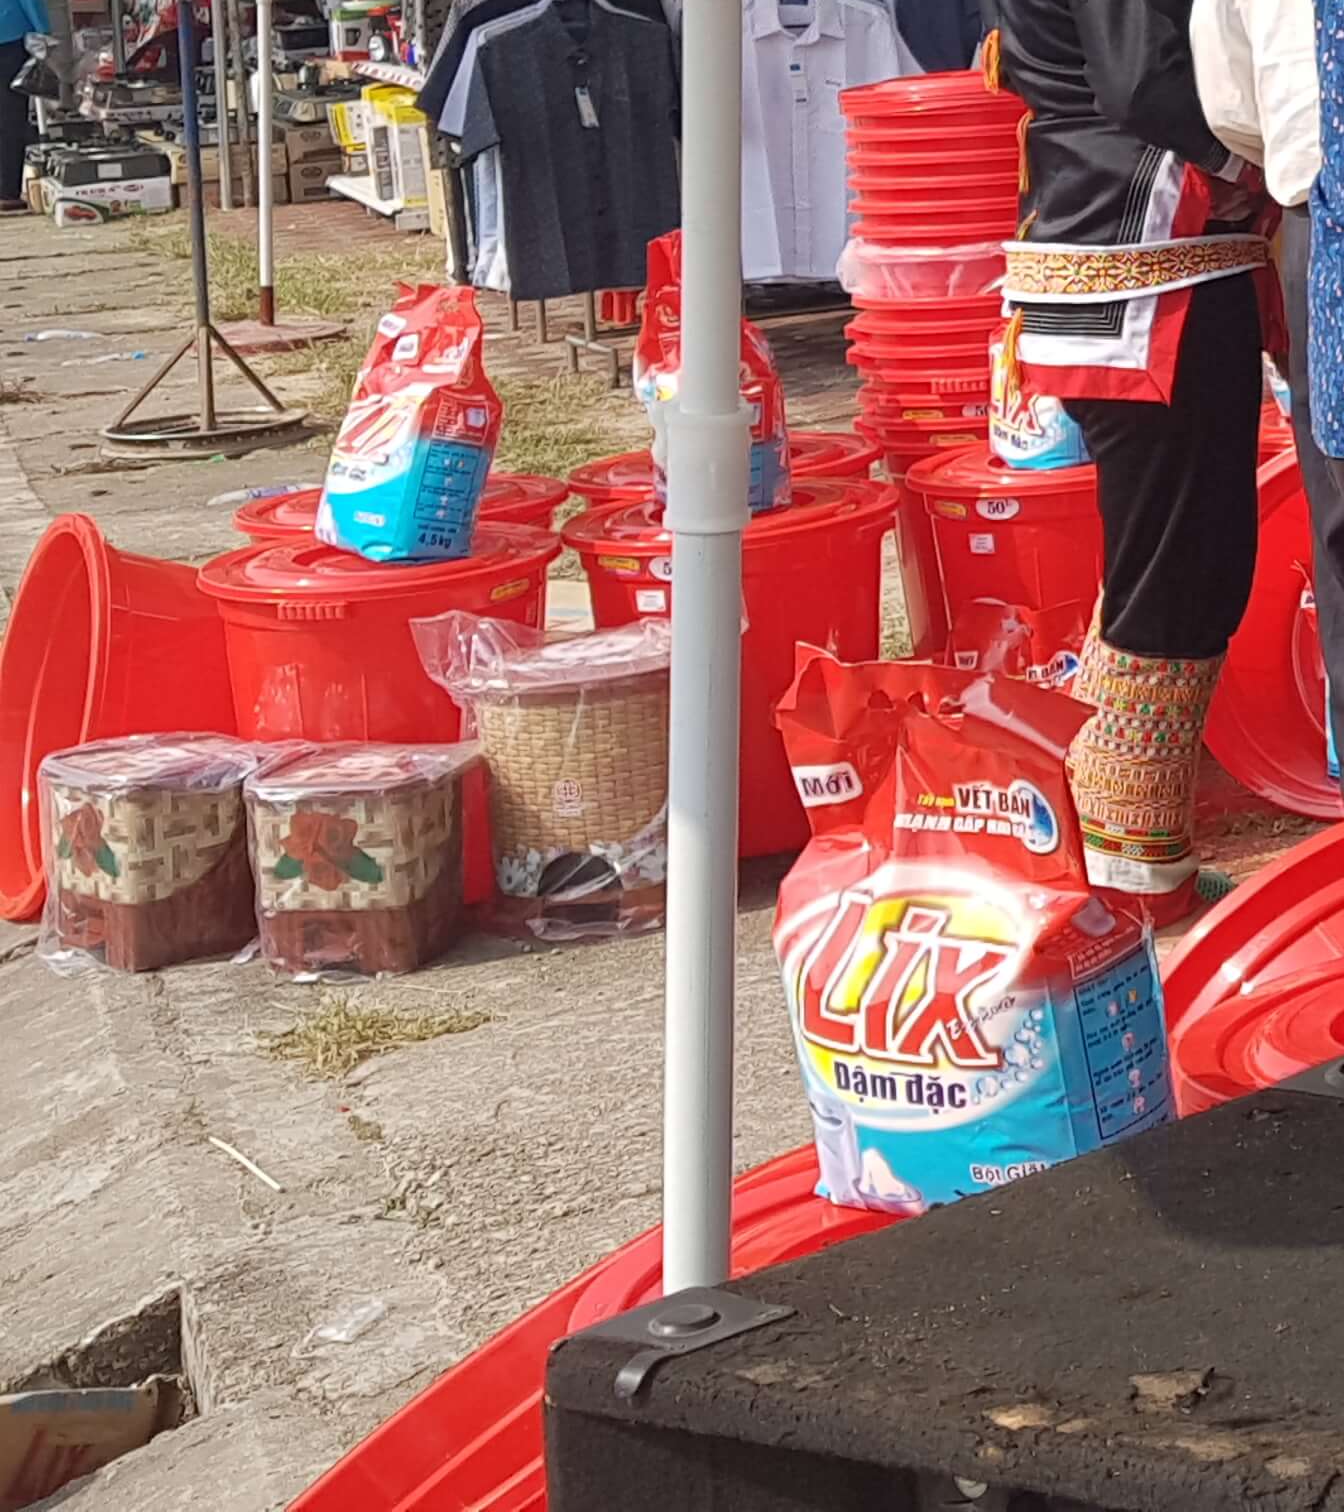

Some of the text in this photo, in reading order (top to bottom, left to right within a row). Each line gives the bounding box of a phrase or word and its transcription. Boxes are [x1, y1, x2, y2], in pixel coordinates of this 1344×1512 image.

[802, 891, 1017, 1070] Lix
[834, 1059, 967, 1110] Đậm đặc
